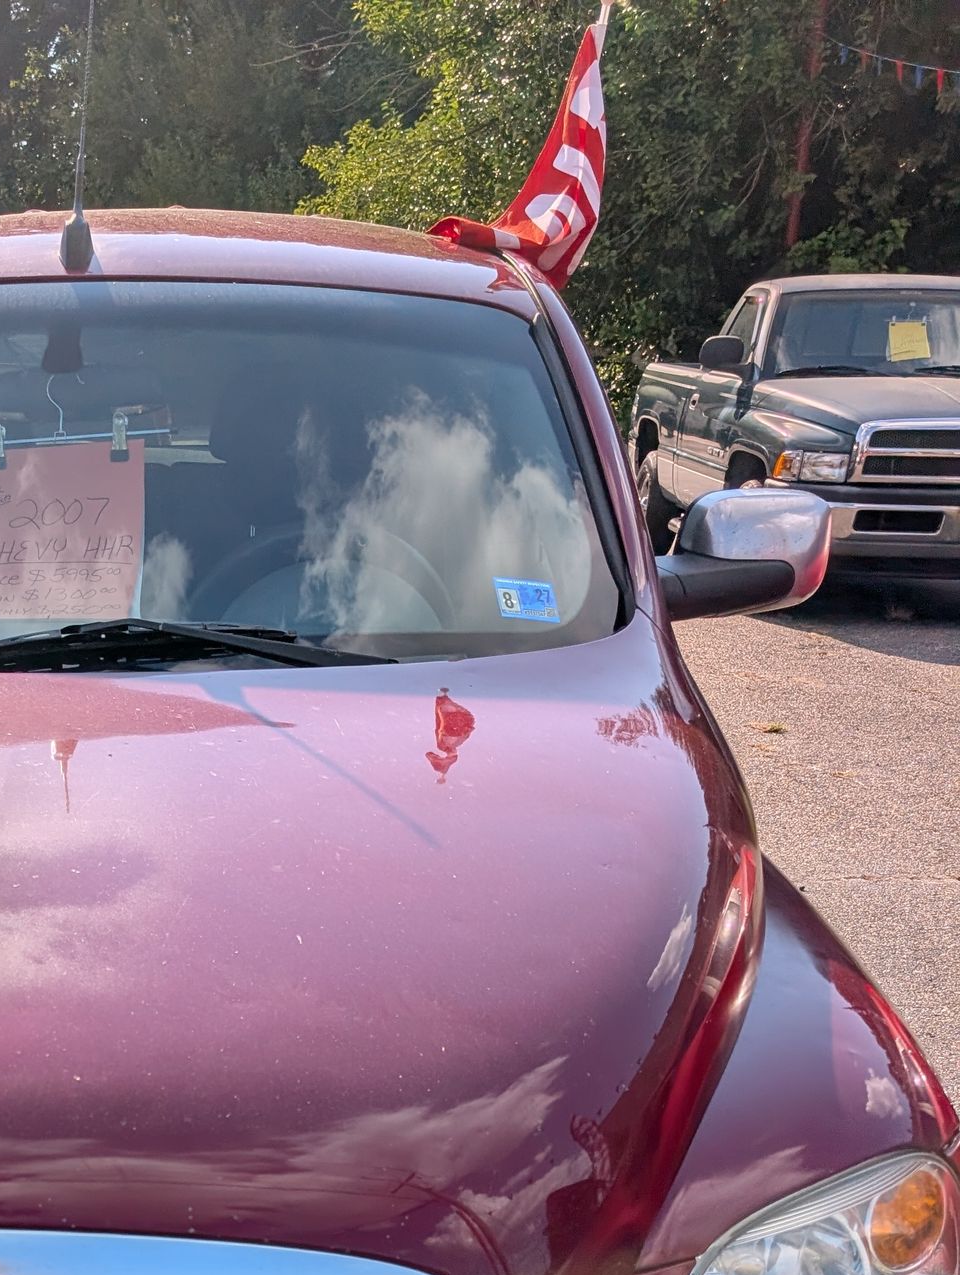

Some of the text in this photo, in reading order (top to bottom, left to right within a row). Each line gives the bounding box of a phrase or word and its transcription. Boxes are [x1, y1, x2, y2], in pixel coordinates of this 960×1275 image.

[8, 497, 111, 530] 2007
[84, 535, 134, 560] HHR
[502, 591, 515, 609] 8
[534, 588, 550, 603] 27
